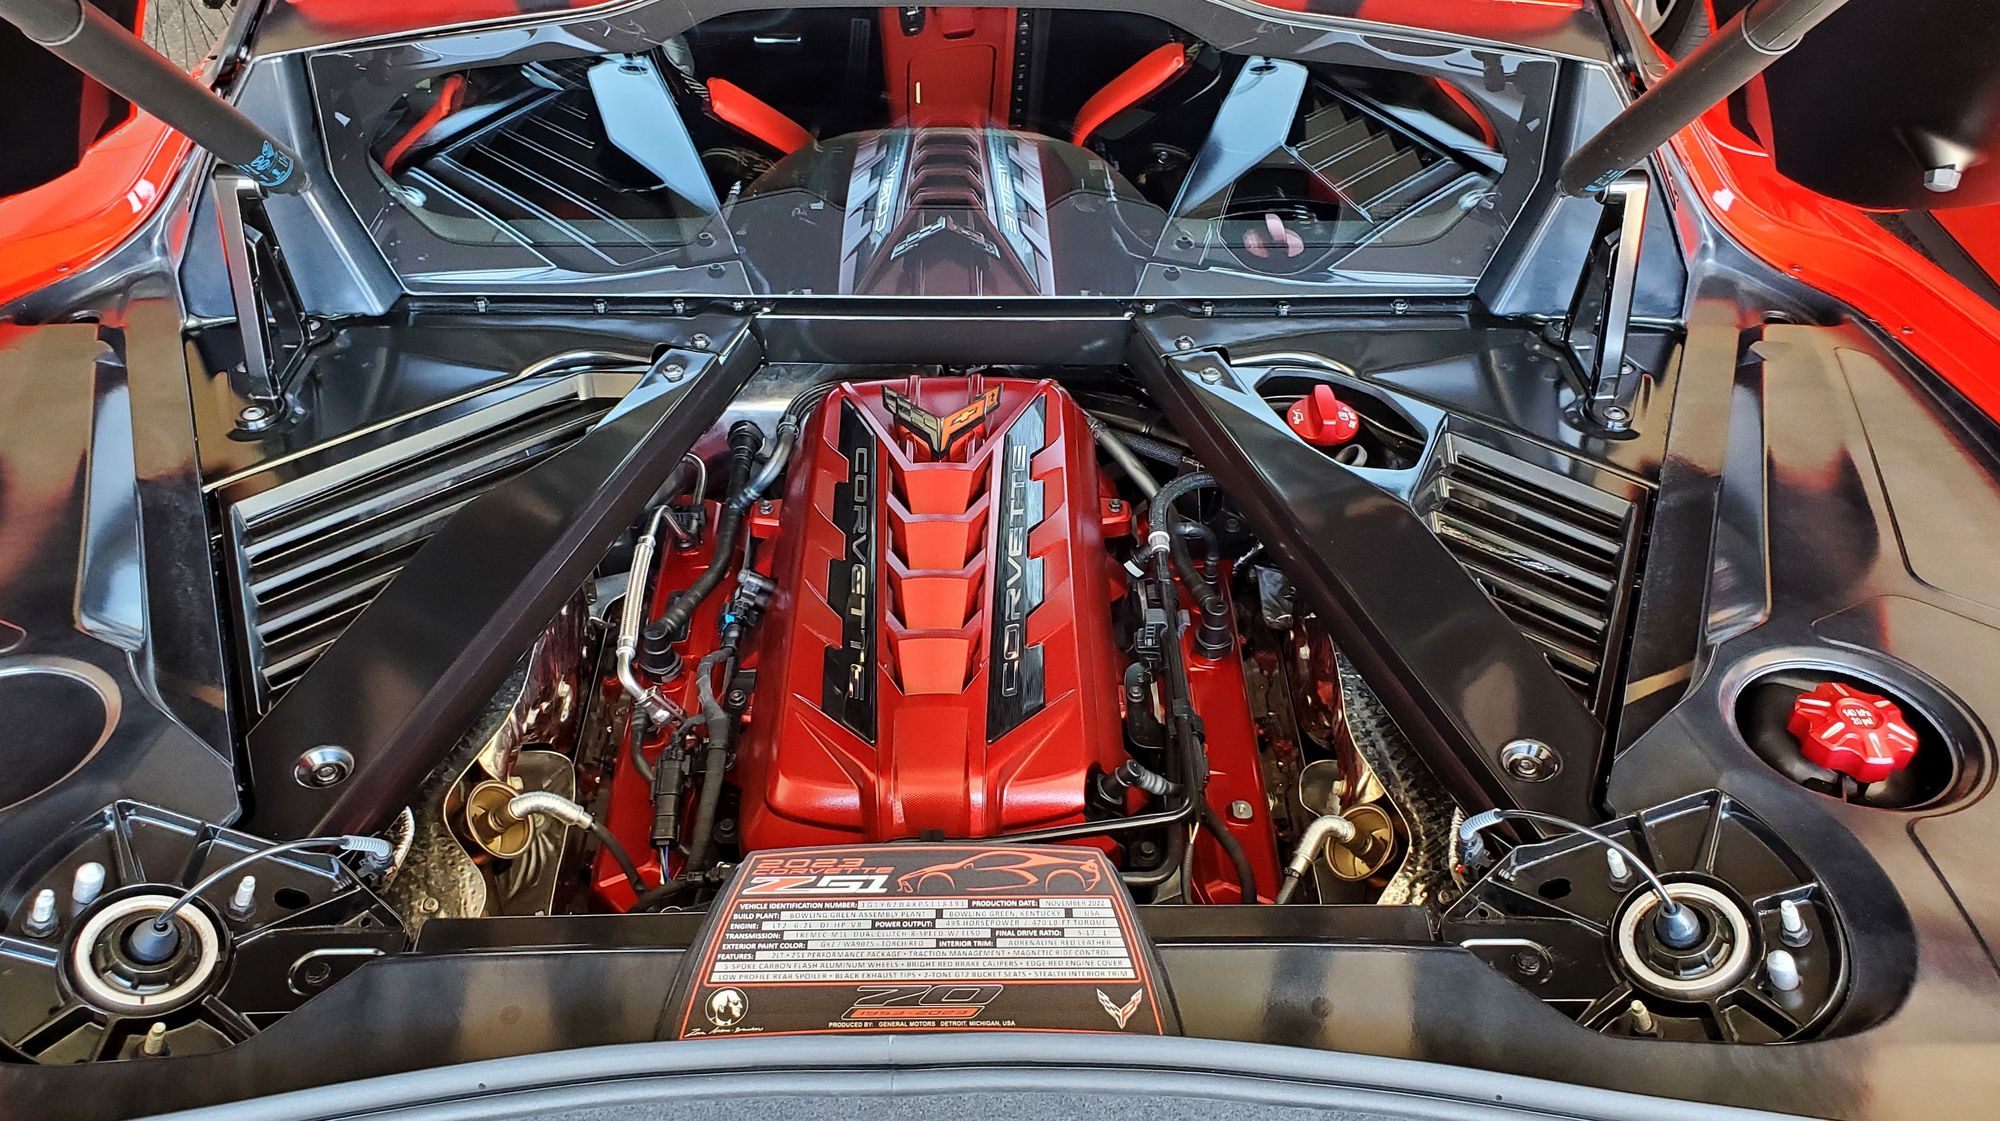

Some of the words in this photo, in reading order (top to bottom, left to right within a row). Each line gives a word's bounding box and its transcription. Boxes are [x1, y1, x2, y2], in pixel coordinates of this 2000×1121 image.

[1002, 445, 1027, 697] CORVETTE
[1842, 709, 1856, 717] 140
[1856, 709, 1872, 717] kPa
[1851, 717, 1861, 725] 20
[1861, 717, 1874, 727] psi
[757, 858, 865, 868] 2023
[751, 867, 895, 876] CORVETTE
[741, 875, 889, 894] Z51
[740, 902, 768, 910] VEHICLE
[769, 902, 823, 910] IDENTIFICATION
[824, 901, 858, 909] NUMBER:
[902, 920, 933, 928] OUTPUT:
[725, 932, 781, 940] TRANSMISSION:
[722, 942, 756, 950] EXTERIOR
[853, 984, 1004, 1007] 70
